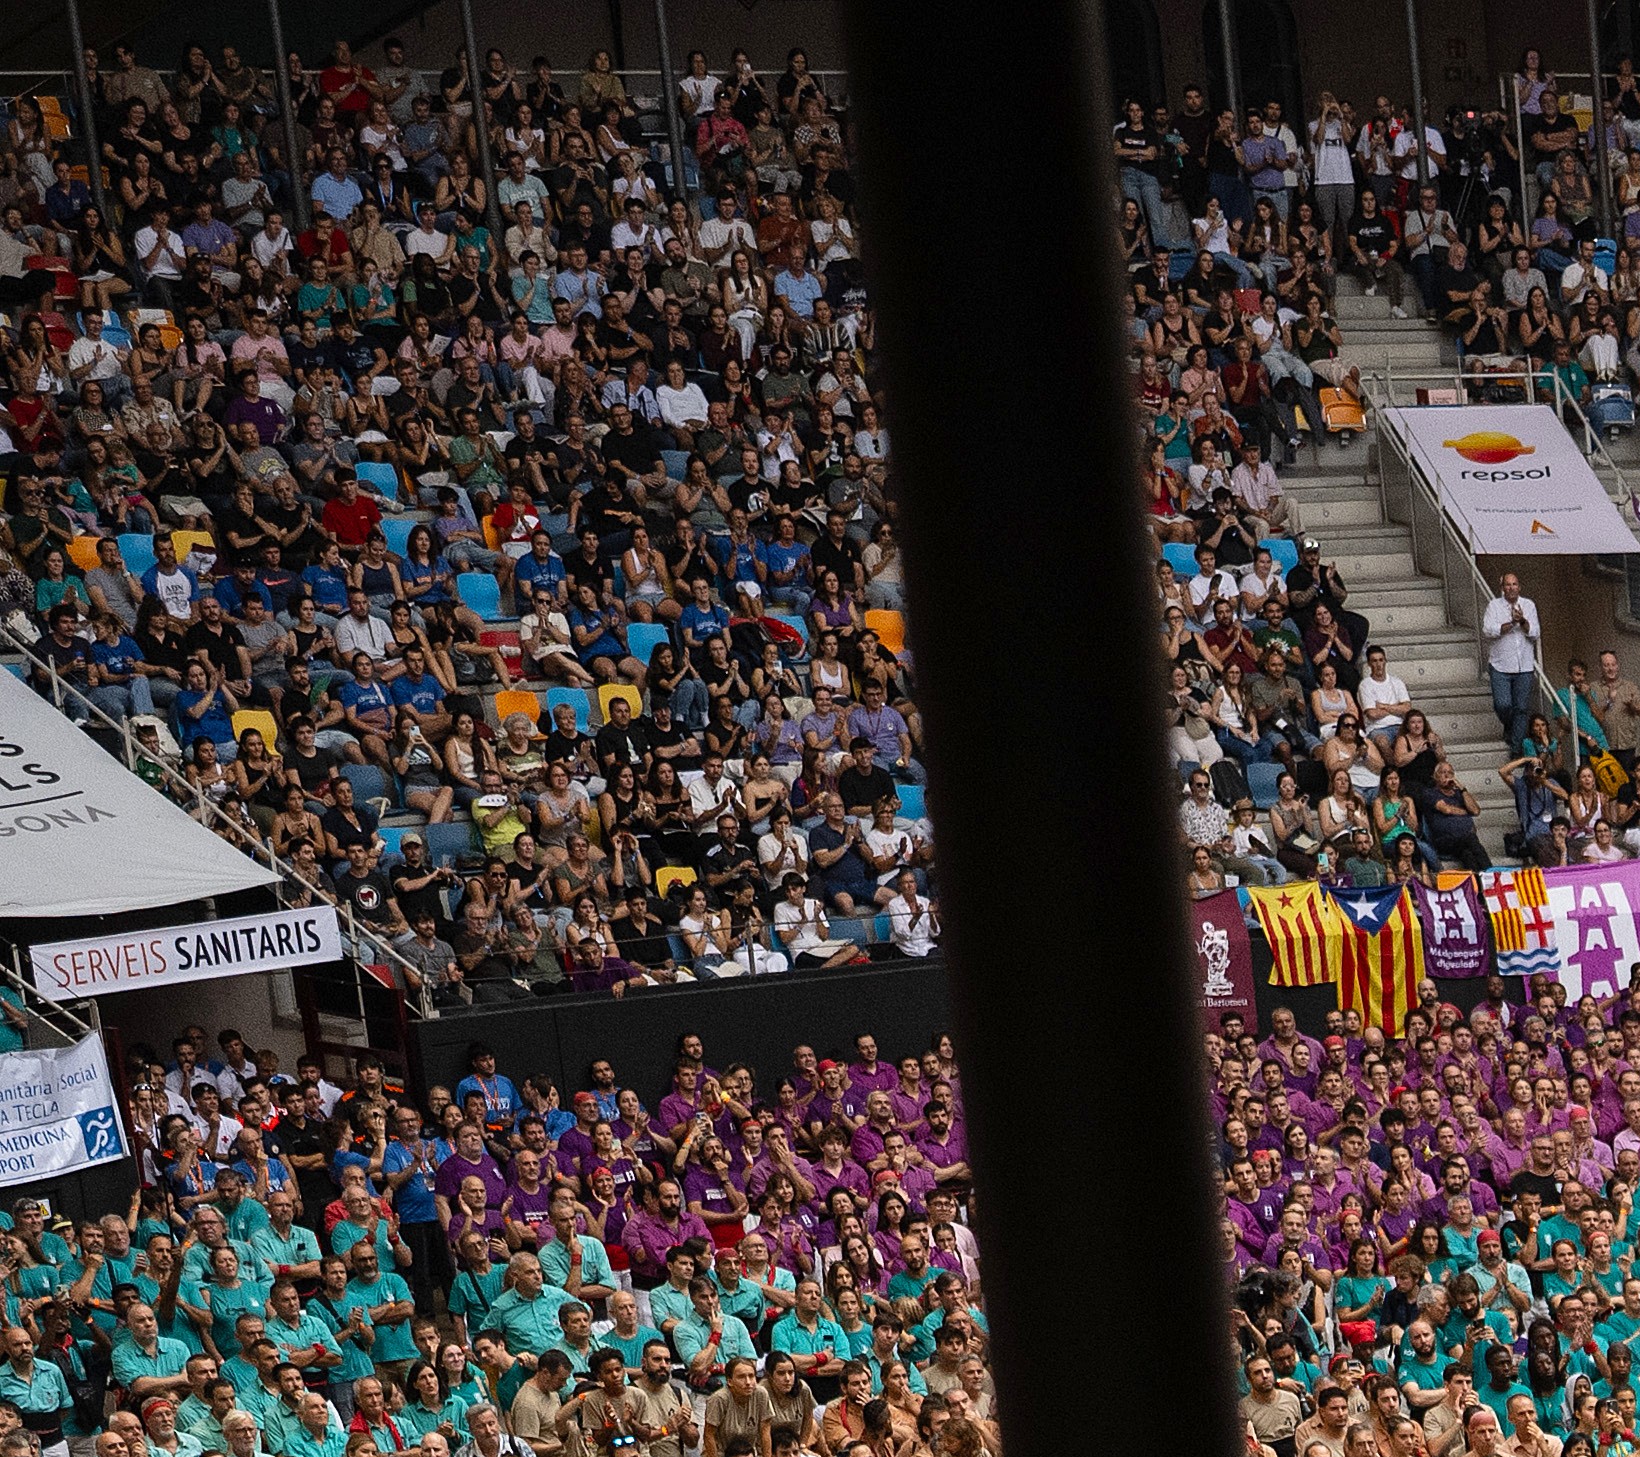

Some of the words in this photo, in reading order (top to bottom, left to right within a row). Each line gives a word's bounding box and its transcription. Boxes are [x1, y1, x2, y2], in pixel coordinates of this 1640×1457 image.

[1460, 465, 1551, 483] repsol
[53, 940, 168, 988] SERVEIS
[175, 919, 321, 970] SANITARIS
[60, 1064, 98, 1090] Social
[13, 1102, 60, 1122] TECLA
[0, 1127, 71, 1151] MEDICINA
